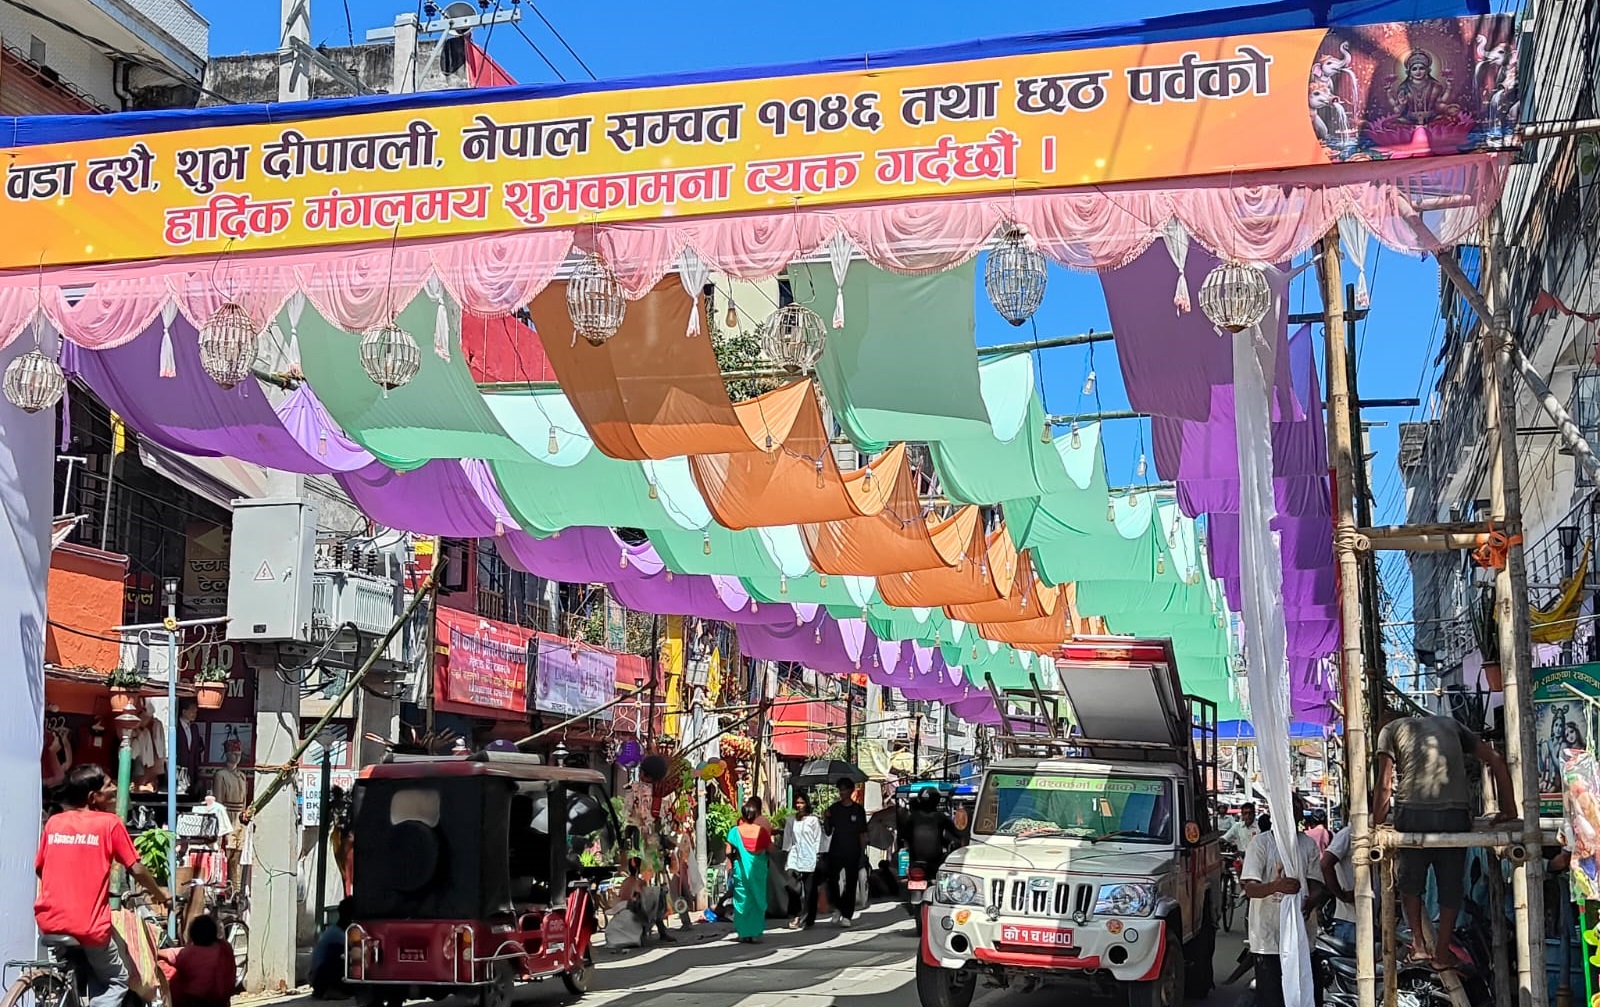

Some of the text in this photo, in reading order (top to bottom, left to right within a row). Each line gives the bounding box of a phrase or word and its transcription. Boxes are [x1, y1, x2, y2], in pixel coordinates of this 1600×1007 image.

[7, 162, 76, 200] वडा
[176, 146, 250, 194] शुभ
[263, 119, 443, 180] दीपावली,
[462, 115, 593, 161] नेपाल
[606, 103, 744, 152] सम्वत
[758, 92, 884, 136] ११४६
[901, 81, 1001, 126] तथा
[1016, 71, 1111, 113] छठ
[1126, 46, 1272, 104] पर्वको
[164, 194, 294, 244] हार्दिक
[305, 185, 491, 230] मंगलमय
[504, 164, 734, 225] शुभकामना
[746, 153, 863, 193] व्यक्त
[1003, 926, 1021, 941] को
